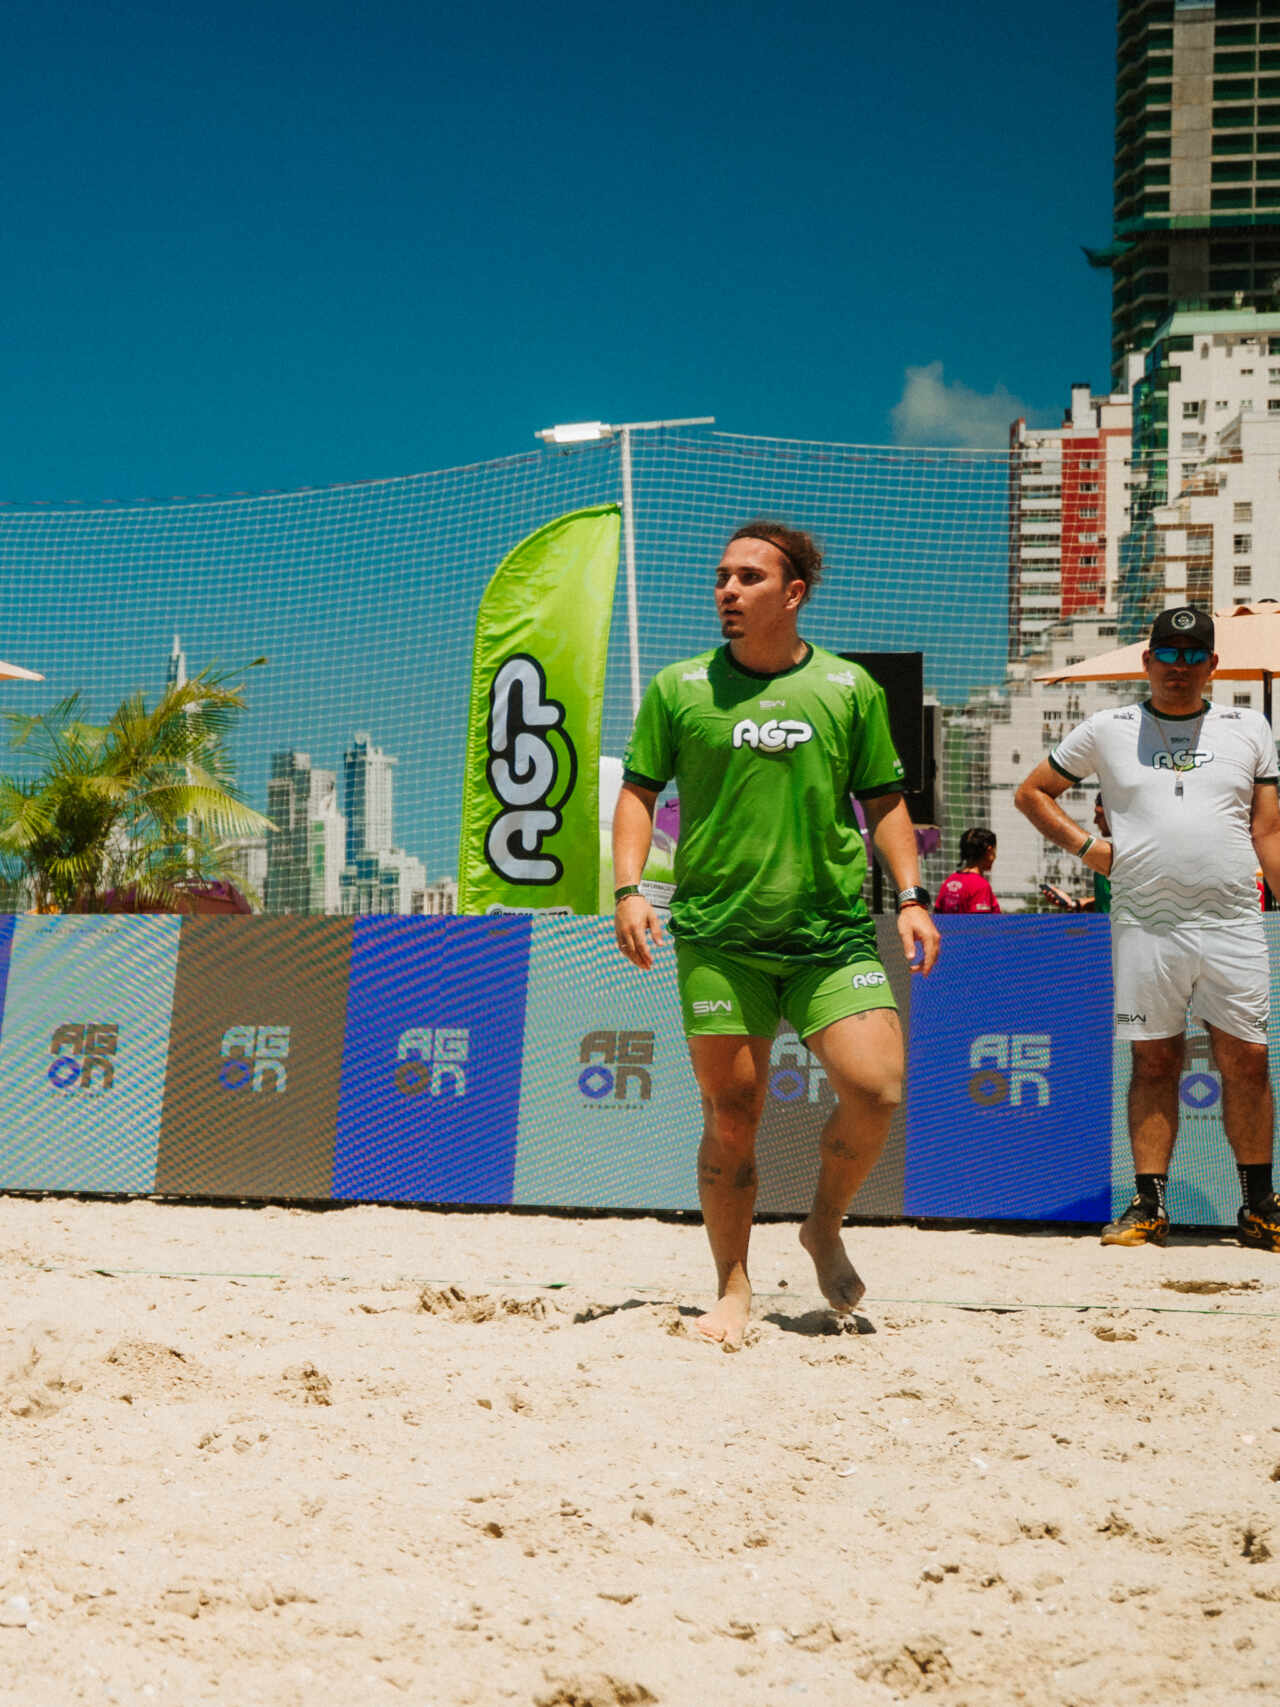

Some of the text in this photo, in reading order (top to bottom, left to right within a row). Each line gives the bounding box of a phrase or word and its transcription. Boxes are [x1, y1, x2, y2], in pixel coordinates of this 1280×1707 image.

[732, 719, 813, 750] AGP
[486, 655, 566, 884] AGP
[1152, 751, 1214, 771] AGP
[852, 972, 887, 989] AGP
[693, 1000, 732, 1015] SW
[1117, 1014, 1146, 1023] SW
[50, 1024, 119, 1055] AG
[221, 1026, 290, 1058] AG
[398, 1028, 469, 1061] AG
[580, 1031, 654, 1064] AG
[970, 1034, 1051, 1069] AG
